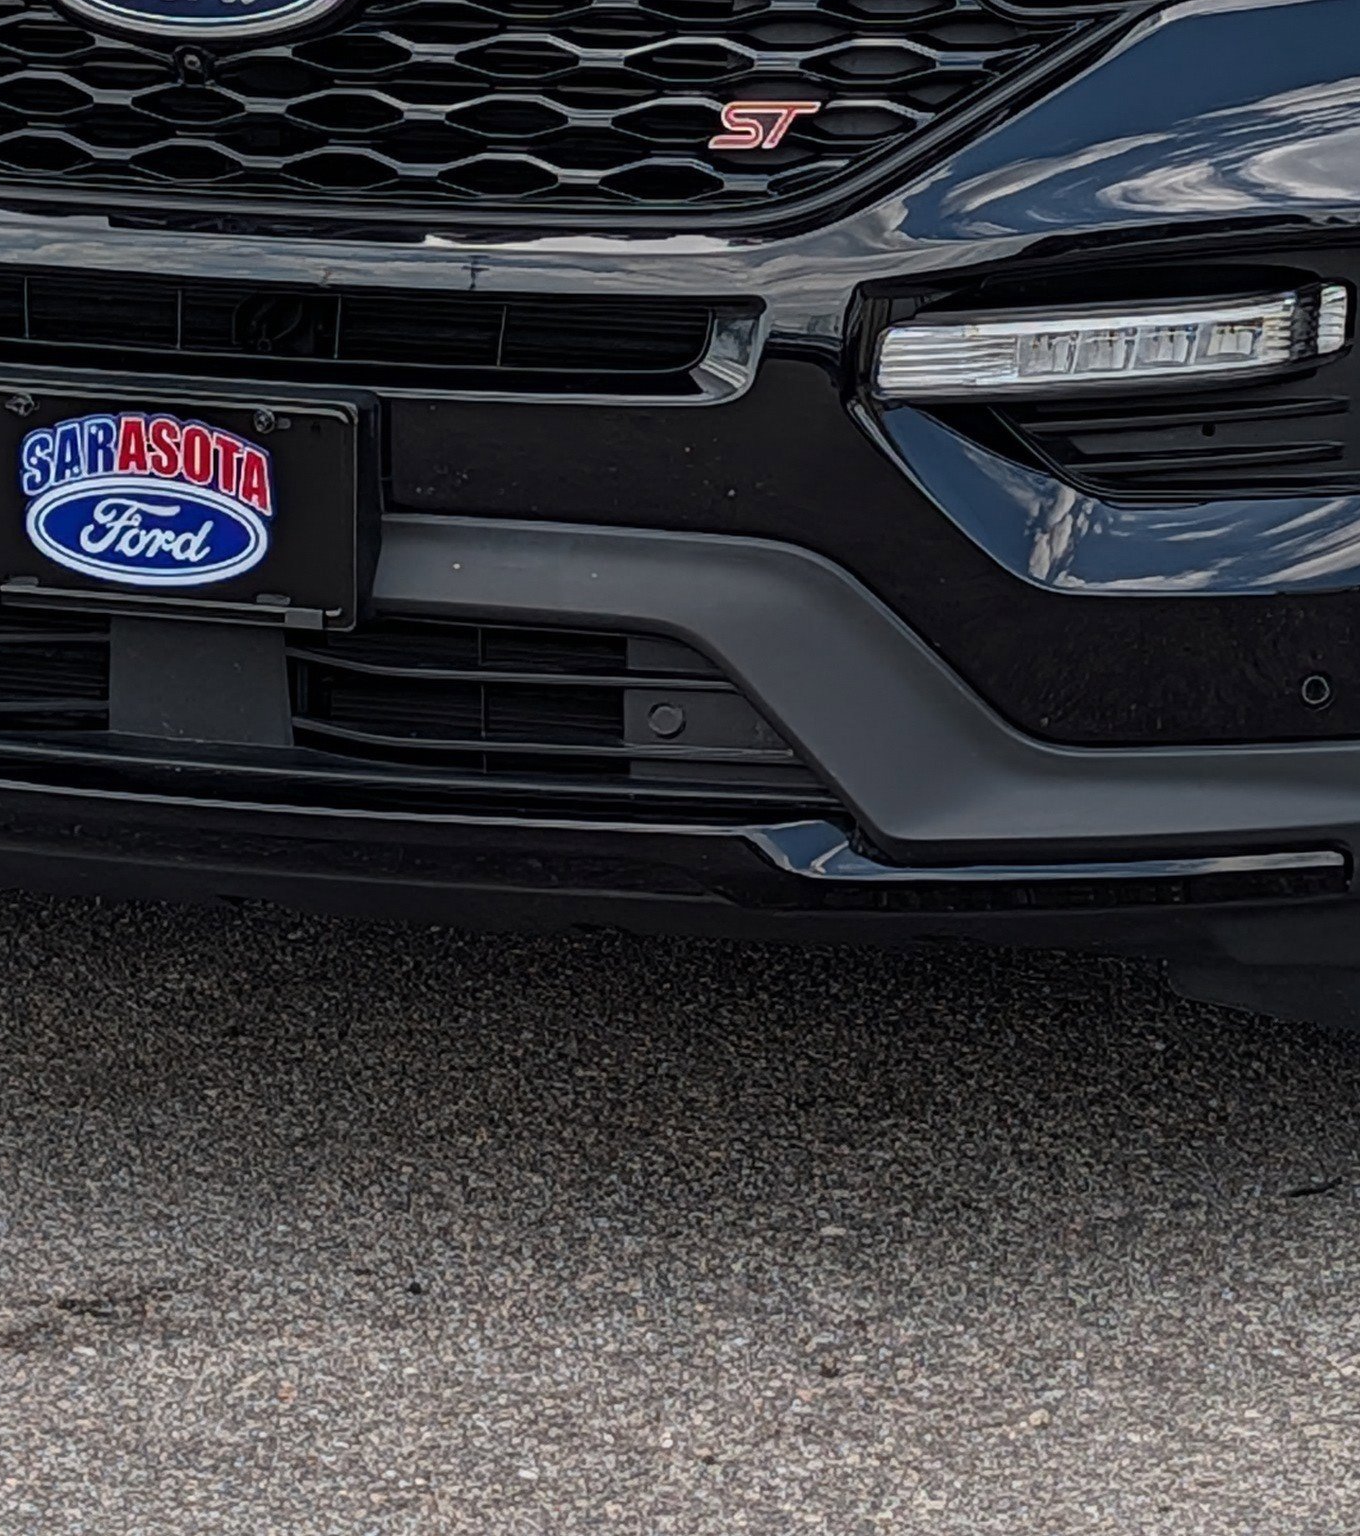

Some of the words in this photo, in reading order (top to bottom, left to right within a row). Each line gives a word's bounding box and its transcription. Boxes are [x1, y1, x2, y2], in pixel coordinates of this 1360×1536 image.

[707, 100, 822, 150] ST
[21, 414, 274, 517] SARASOTA
[80, 497, 215, 564] Ford
